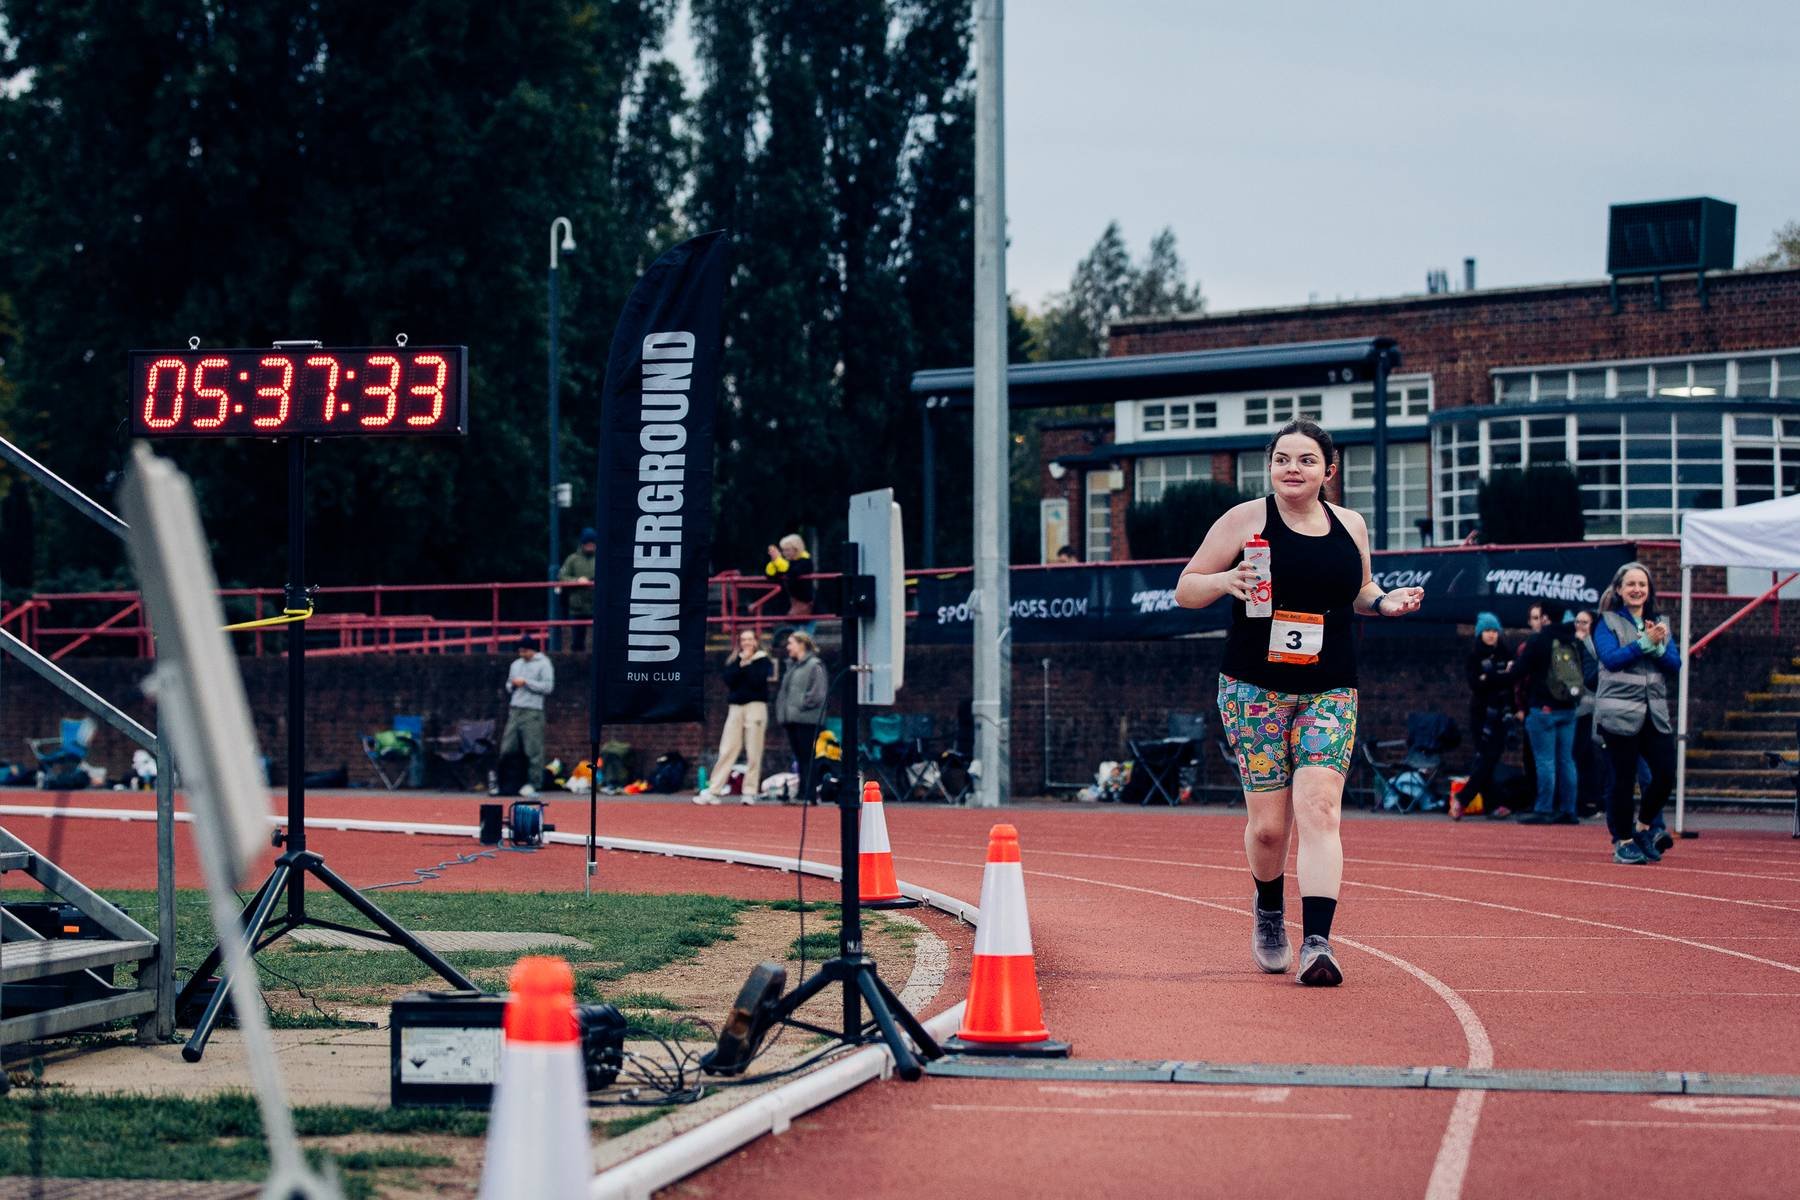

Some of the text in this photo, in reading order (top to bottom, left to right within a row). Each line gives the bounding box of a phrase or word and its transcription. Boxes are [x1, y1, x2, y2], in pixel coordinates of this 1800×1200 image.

[144, 355, 447, 428] 05:37:33
[627, 331, 696, 662] UNDERGROUND
[1486, 569, 1585, 588] UNRIVALLED
[1497, 582, 1599, 603] IN RUNNING
[937, 597, 1089, 624] SPOHOES.COM
[1285, 630, 1303, 650] 3
[627, 672, 680, 682] RUN CLUB
